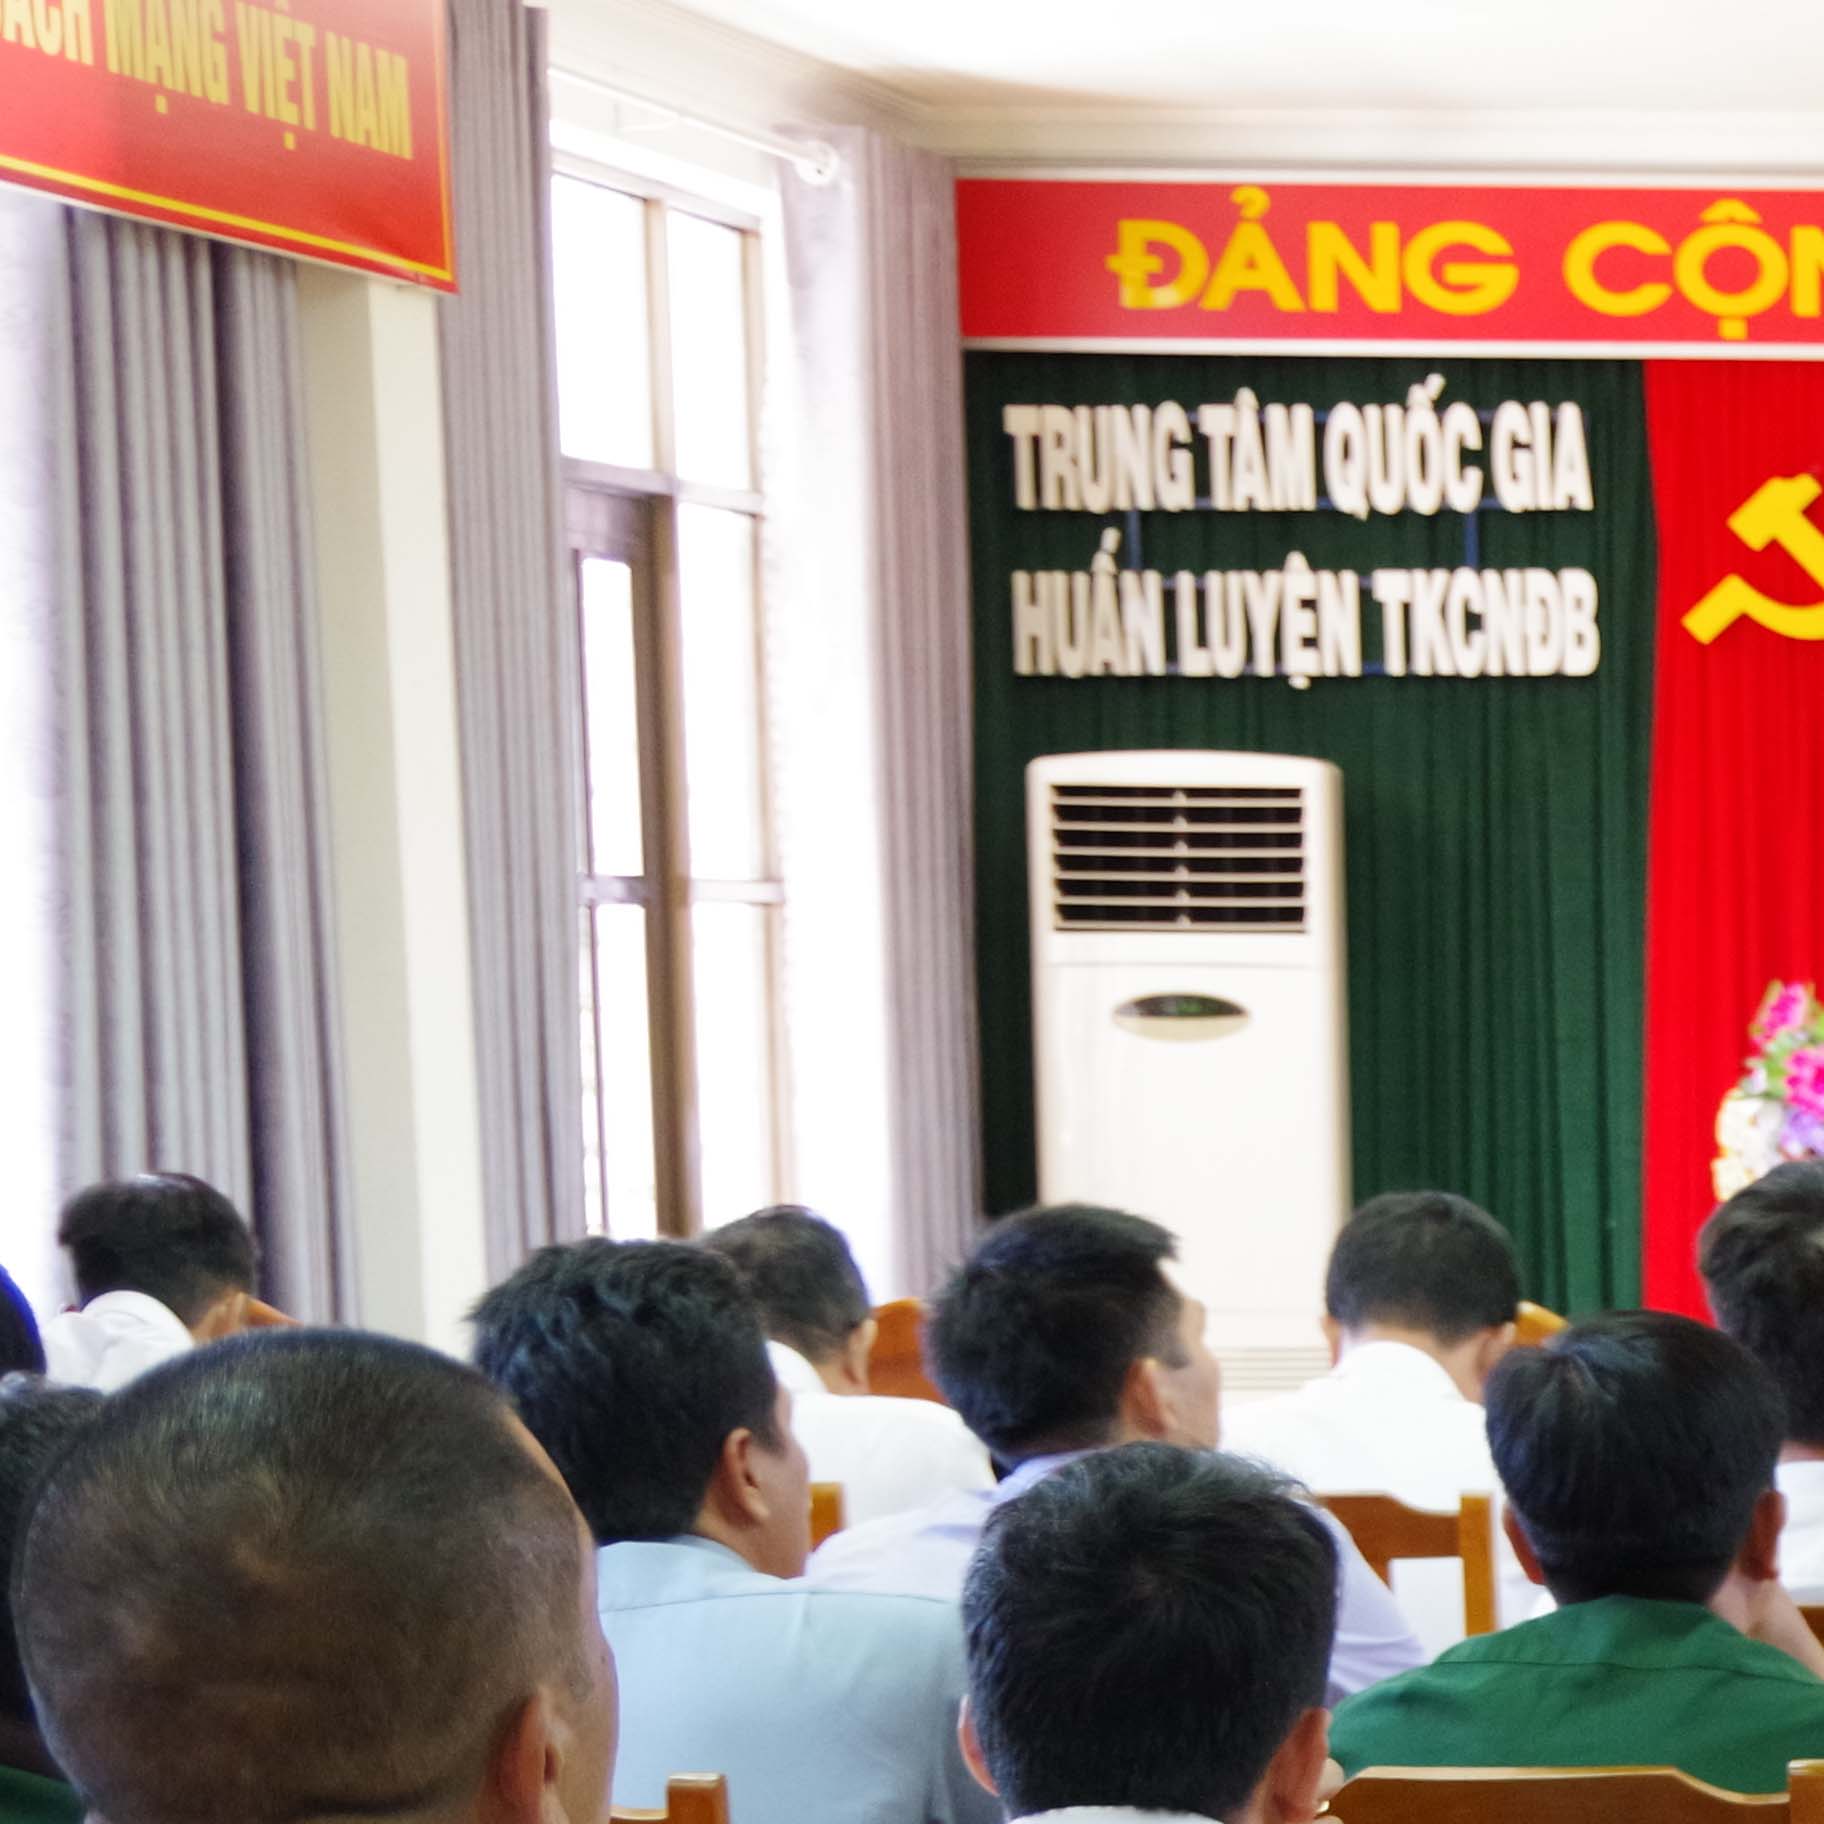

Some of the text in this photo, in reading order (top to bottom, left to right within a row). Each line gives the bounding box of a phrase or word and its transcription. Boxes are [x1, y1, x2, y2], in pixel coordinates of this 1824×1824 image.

[234, 0, 317, 151] VIỆT
[325, 31, 414, 161] NAM
[1106, 186, 1518, 314] ĐẢNG
[1004, 373, 1594, 520] TRUNG TÂM QUỐC GIA
[1011, 526, 1601, 690] HUẤN LUYỆN TKCNĐB
